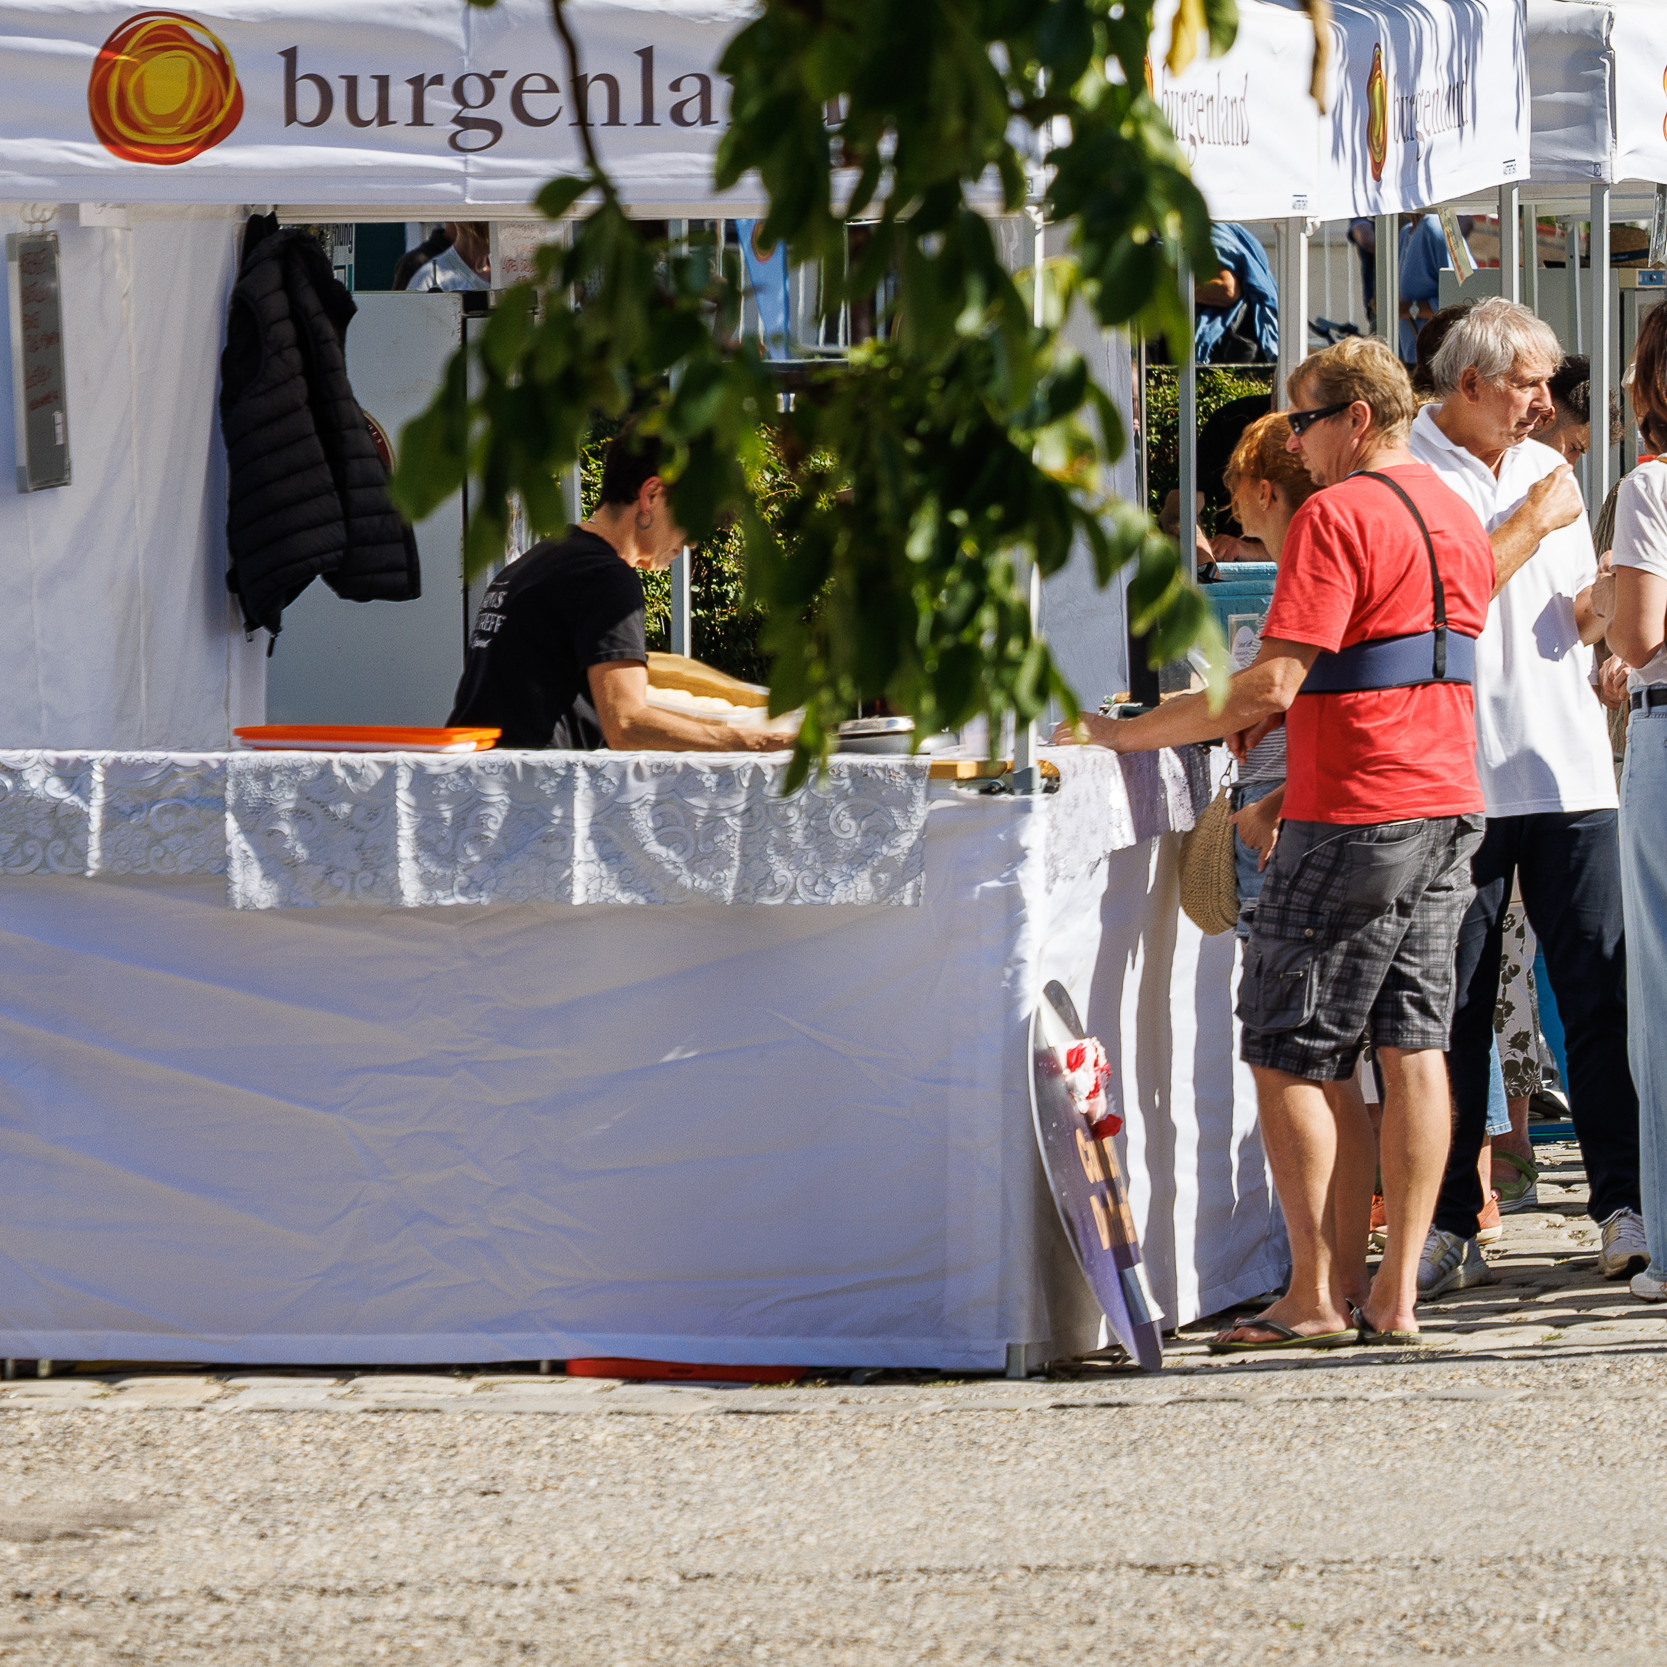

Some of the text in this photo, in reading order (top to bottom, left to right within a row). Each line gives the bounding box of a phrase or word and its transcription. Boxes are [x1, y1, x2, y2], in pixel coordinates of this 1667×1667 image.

[279, 44, 847, 153] burgenla
[1161, 61, 1250, 169] burgenland
[1393, 60, 1469, 162] burgenland
